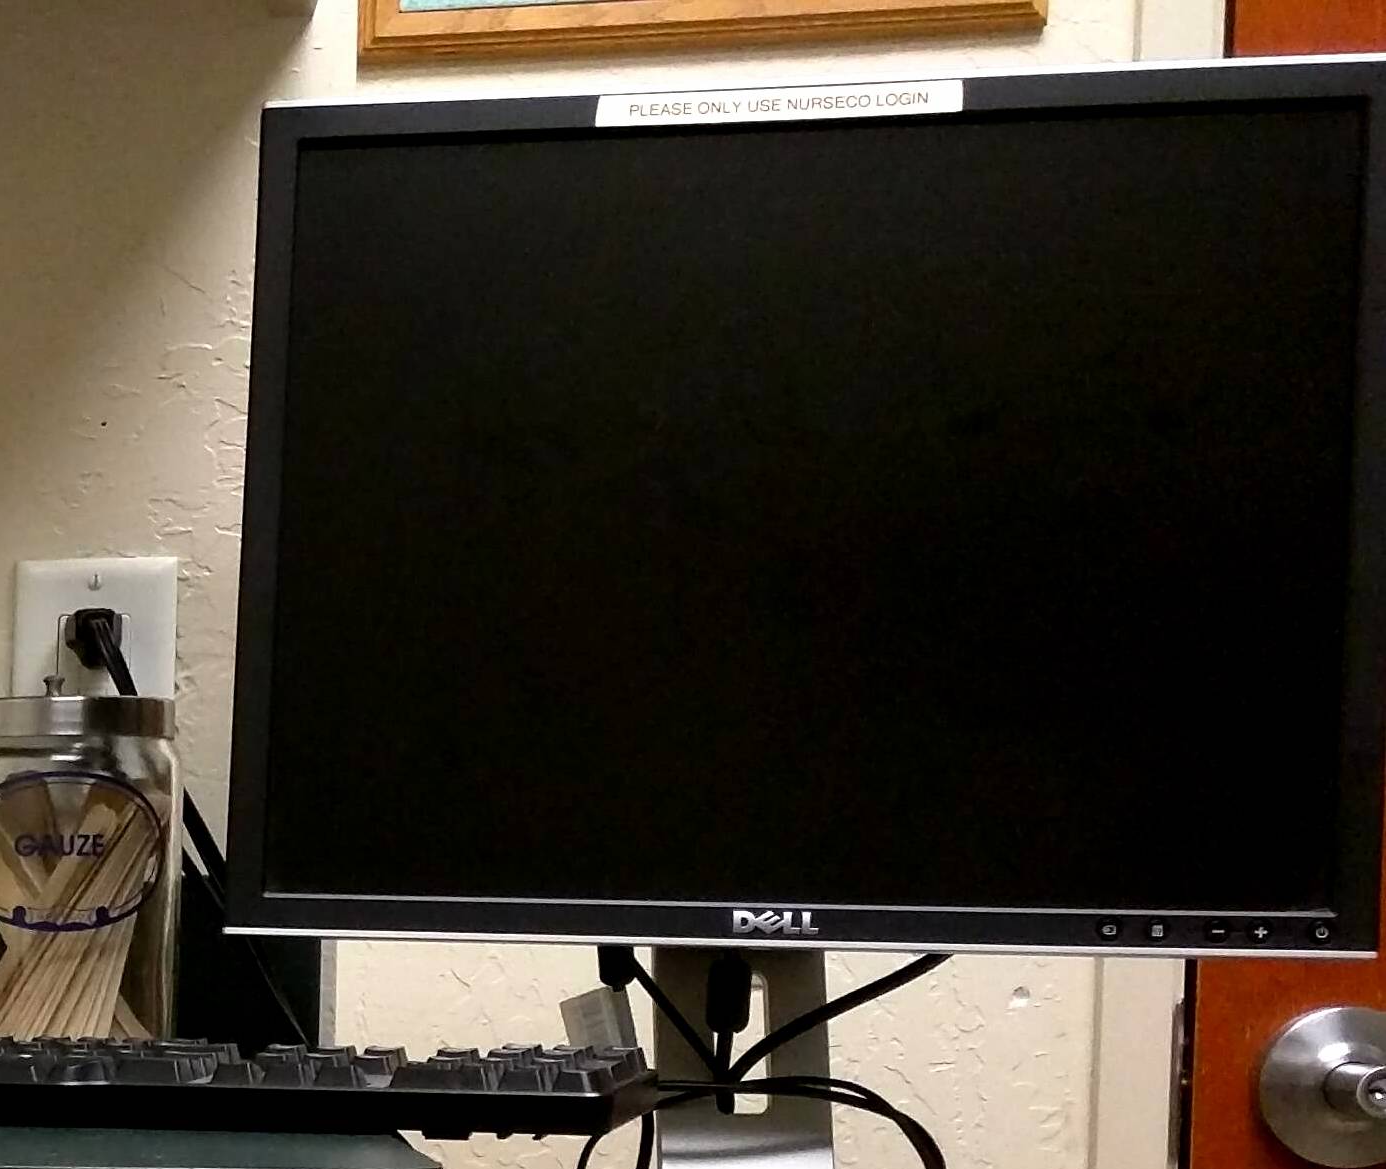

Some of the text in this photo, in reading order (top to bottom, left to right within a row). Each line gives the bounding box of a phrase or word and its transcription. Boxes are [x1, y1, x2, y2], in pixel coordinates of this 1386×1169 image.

[629, 92, 929, 117] PLEASE ONLY USE NURSECO LOGIN
[15, 833, 105, 857] GAUZE
[732, 910, 819, 935] DELL
